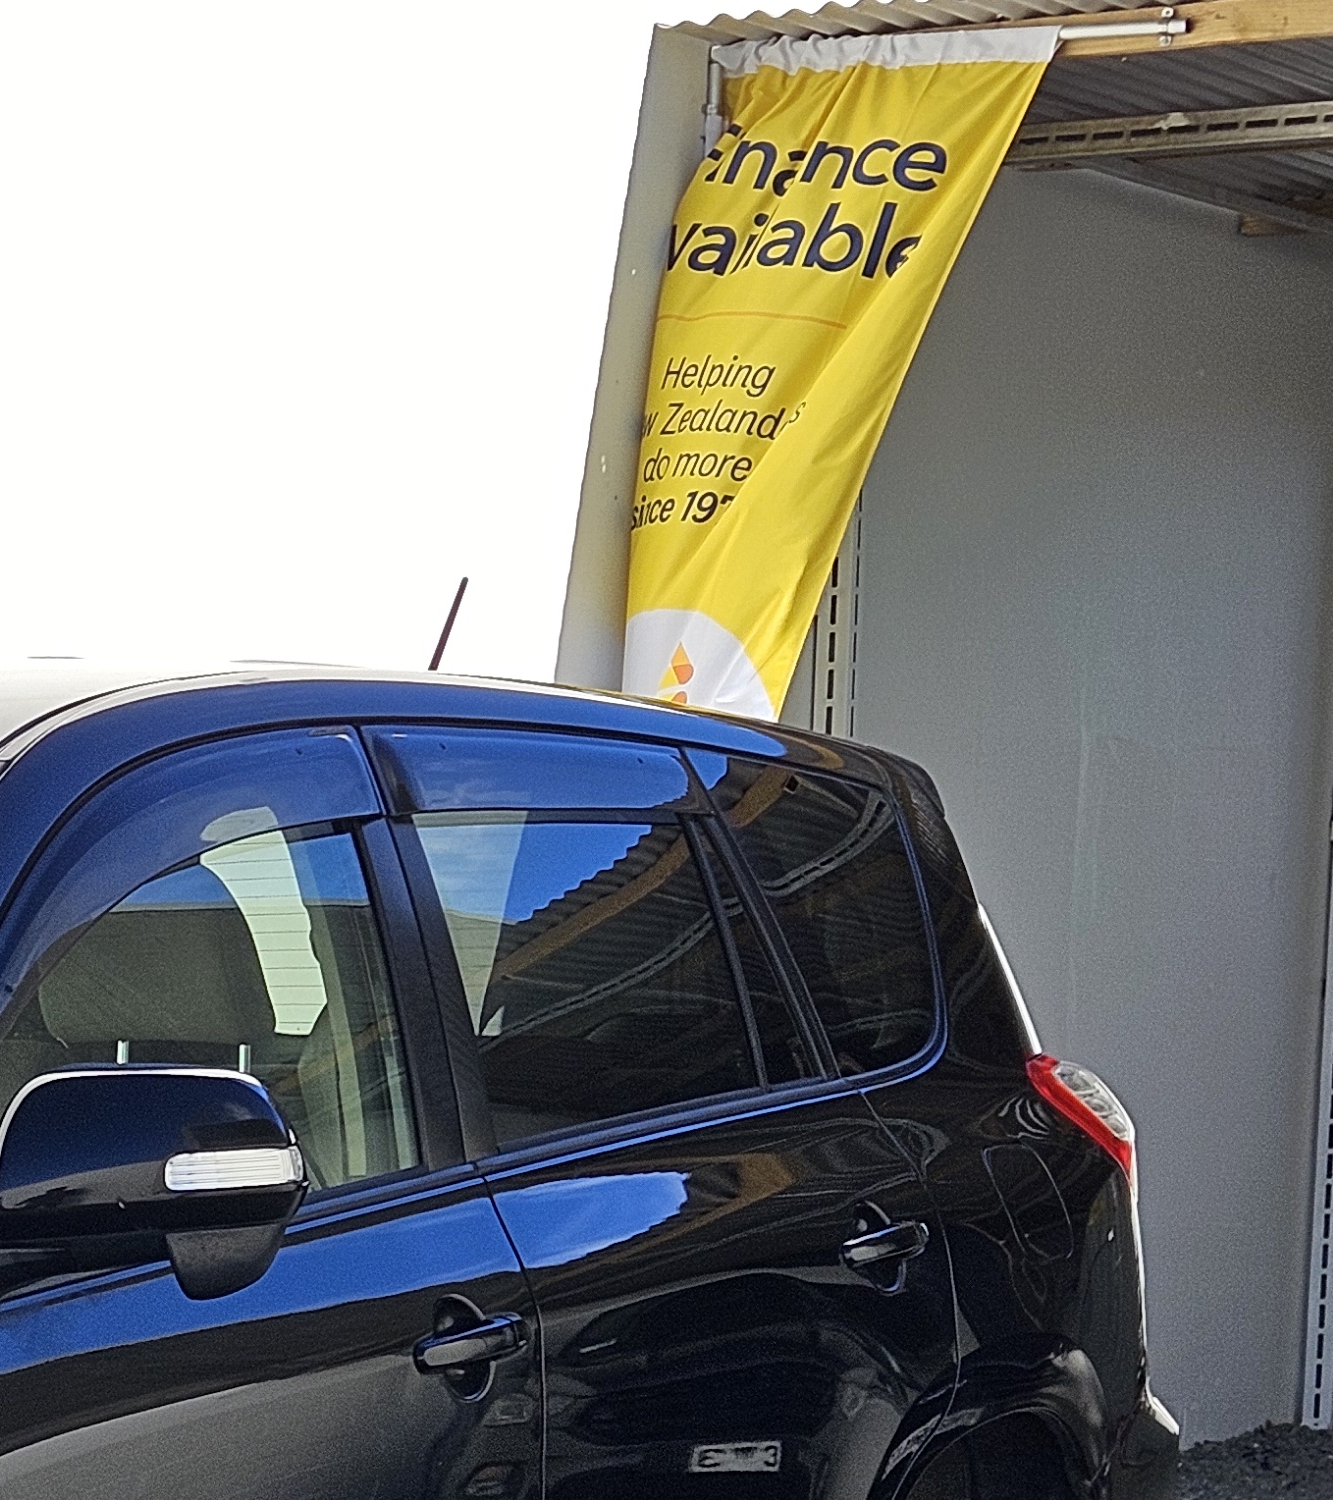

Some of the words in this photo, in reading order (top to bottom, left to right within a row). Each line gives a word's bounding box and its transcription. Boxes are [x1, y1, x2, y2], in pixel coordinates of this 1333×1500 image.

[661, 354, 776, 397] Helping
[643, 447, 671, 483] do
[672, 452, 753, 482] more
[632, 494, 675, 530] since
